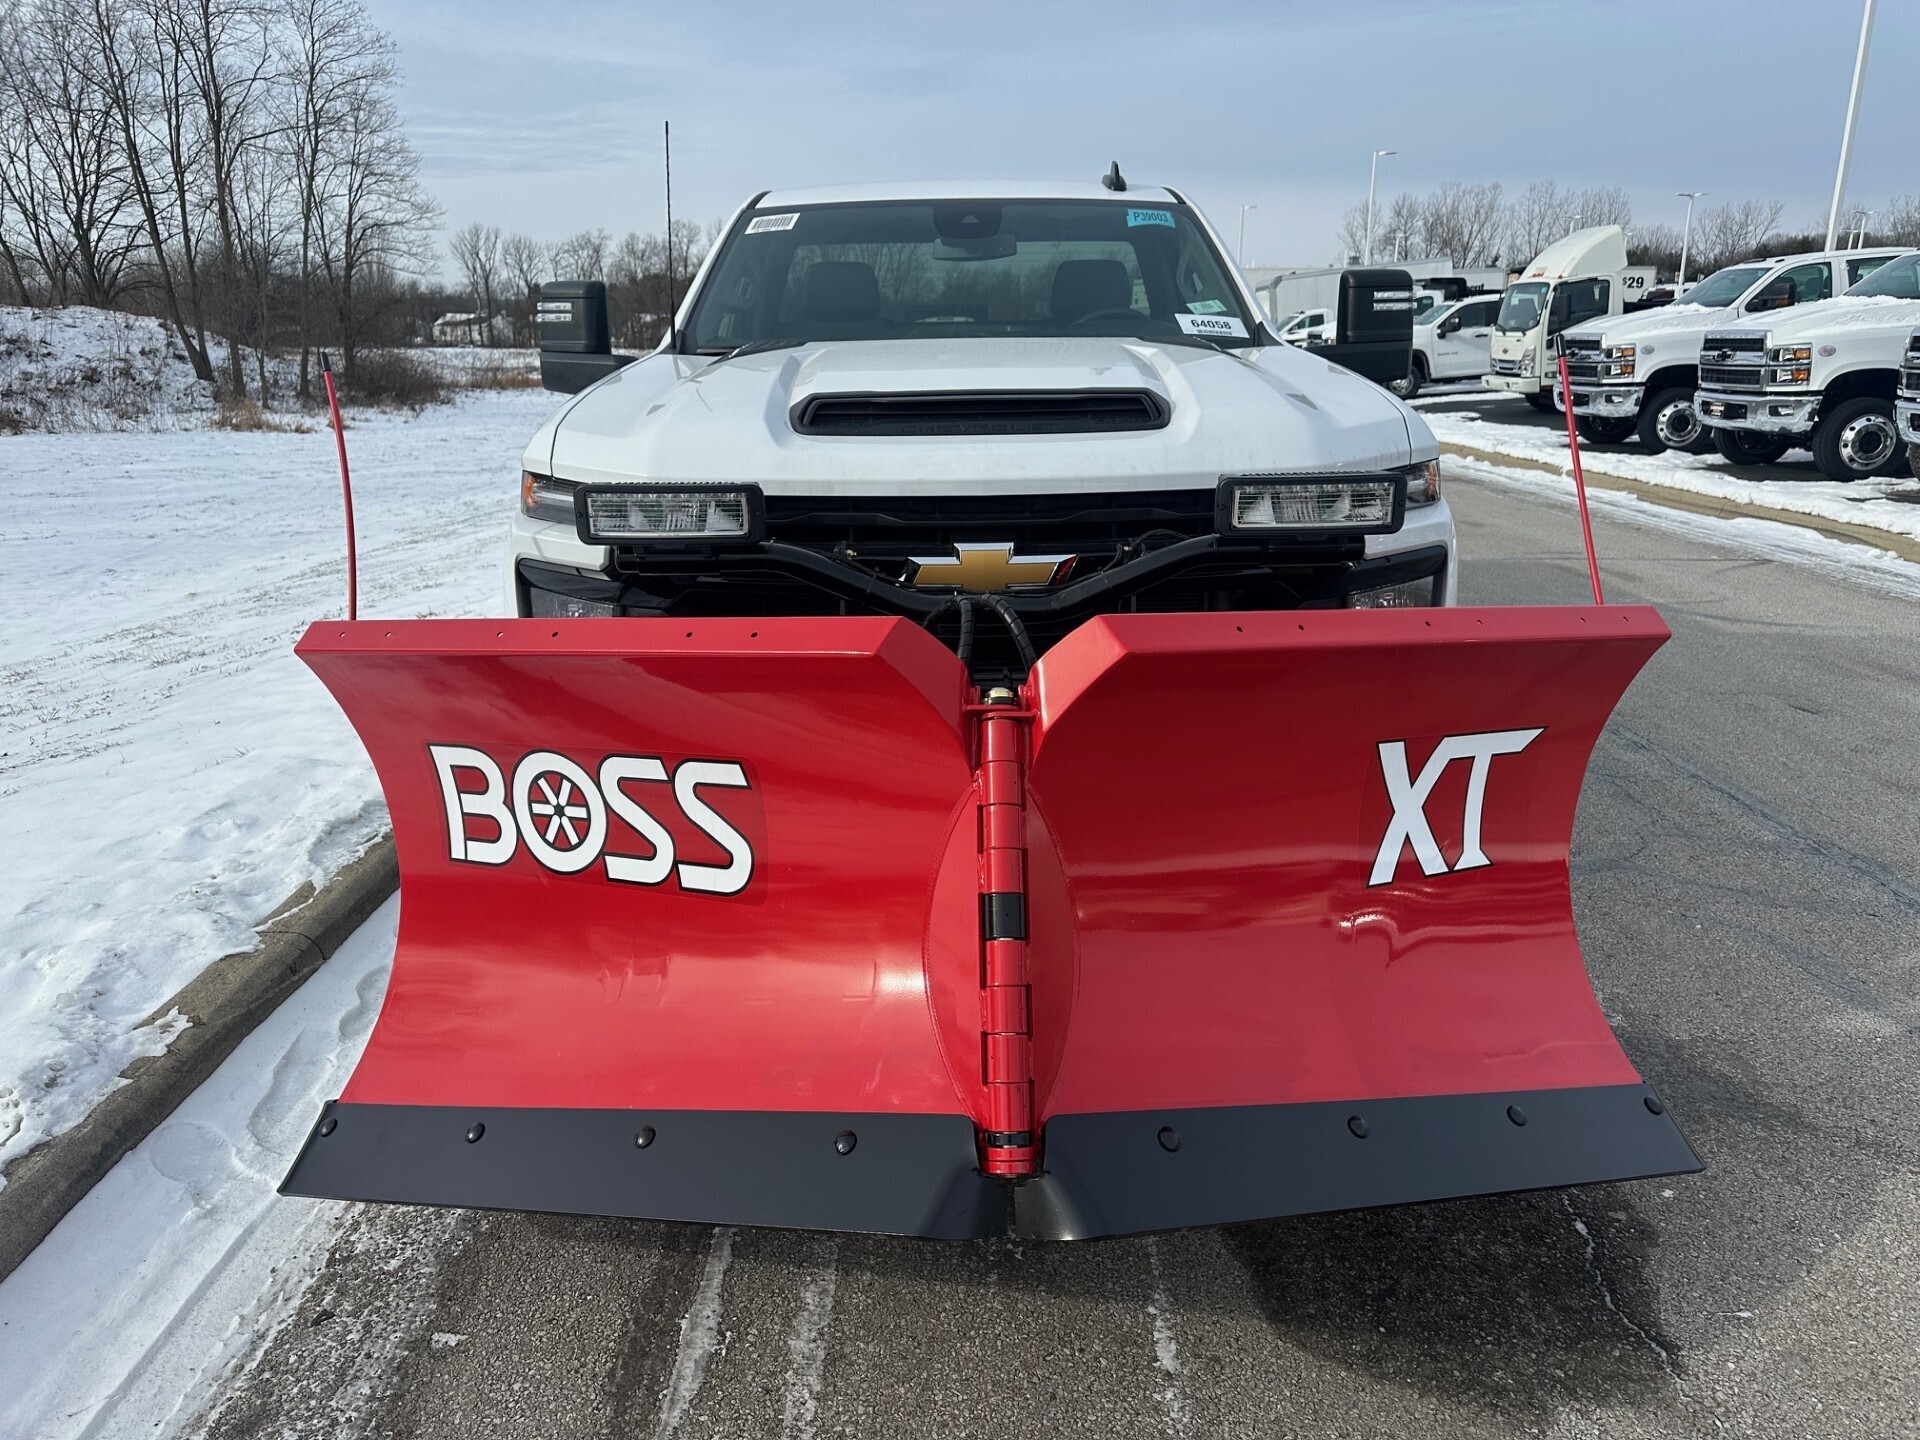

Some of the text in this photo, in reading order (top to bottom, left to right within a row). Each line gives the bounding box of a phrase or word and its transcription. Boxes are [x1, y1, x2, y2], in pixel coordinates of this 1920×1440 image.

[1132, 211, 1168, 222] P39003
[1622, 276, 1644, 289] $29
[1190, 319, 1232, 330] 64058
[1367, 726, 1549, 888] XT
[427, 742, 755, 897] BOSS
